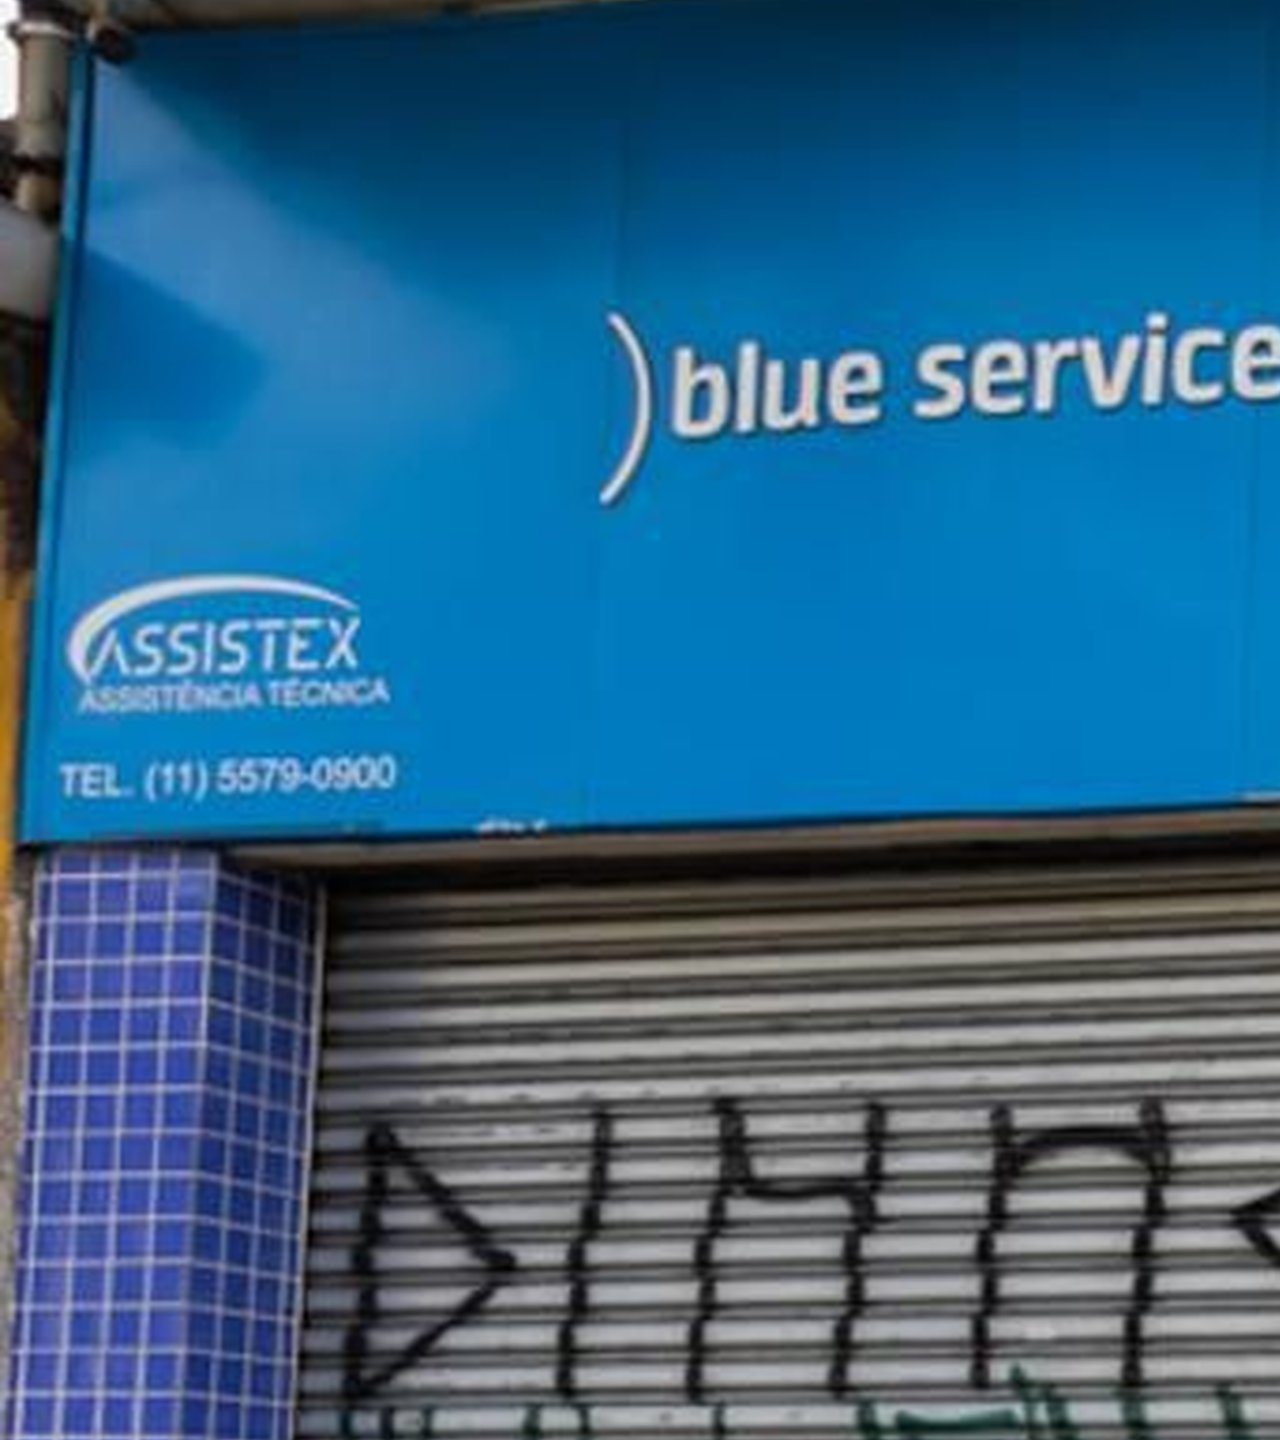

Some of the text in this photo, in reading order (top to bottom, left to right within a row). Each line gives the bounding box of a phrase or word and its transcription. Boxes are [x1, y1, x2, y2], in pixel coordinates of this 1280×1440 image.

[670, 344, 882, 440] blue
[84, 615, 362, 681] ASSISTEX
[78, 676, 392, 714] ASSISTÊNCIA TÉCNICA
[60, 754, 398, 802] TEL. (11) 5579-0900
